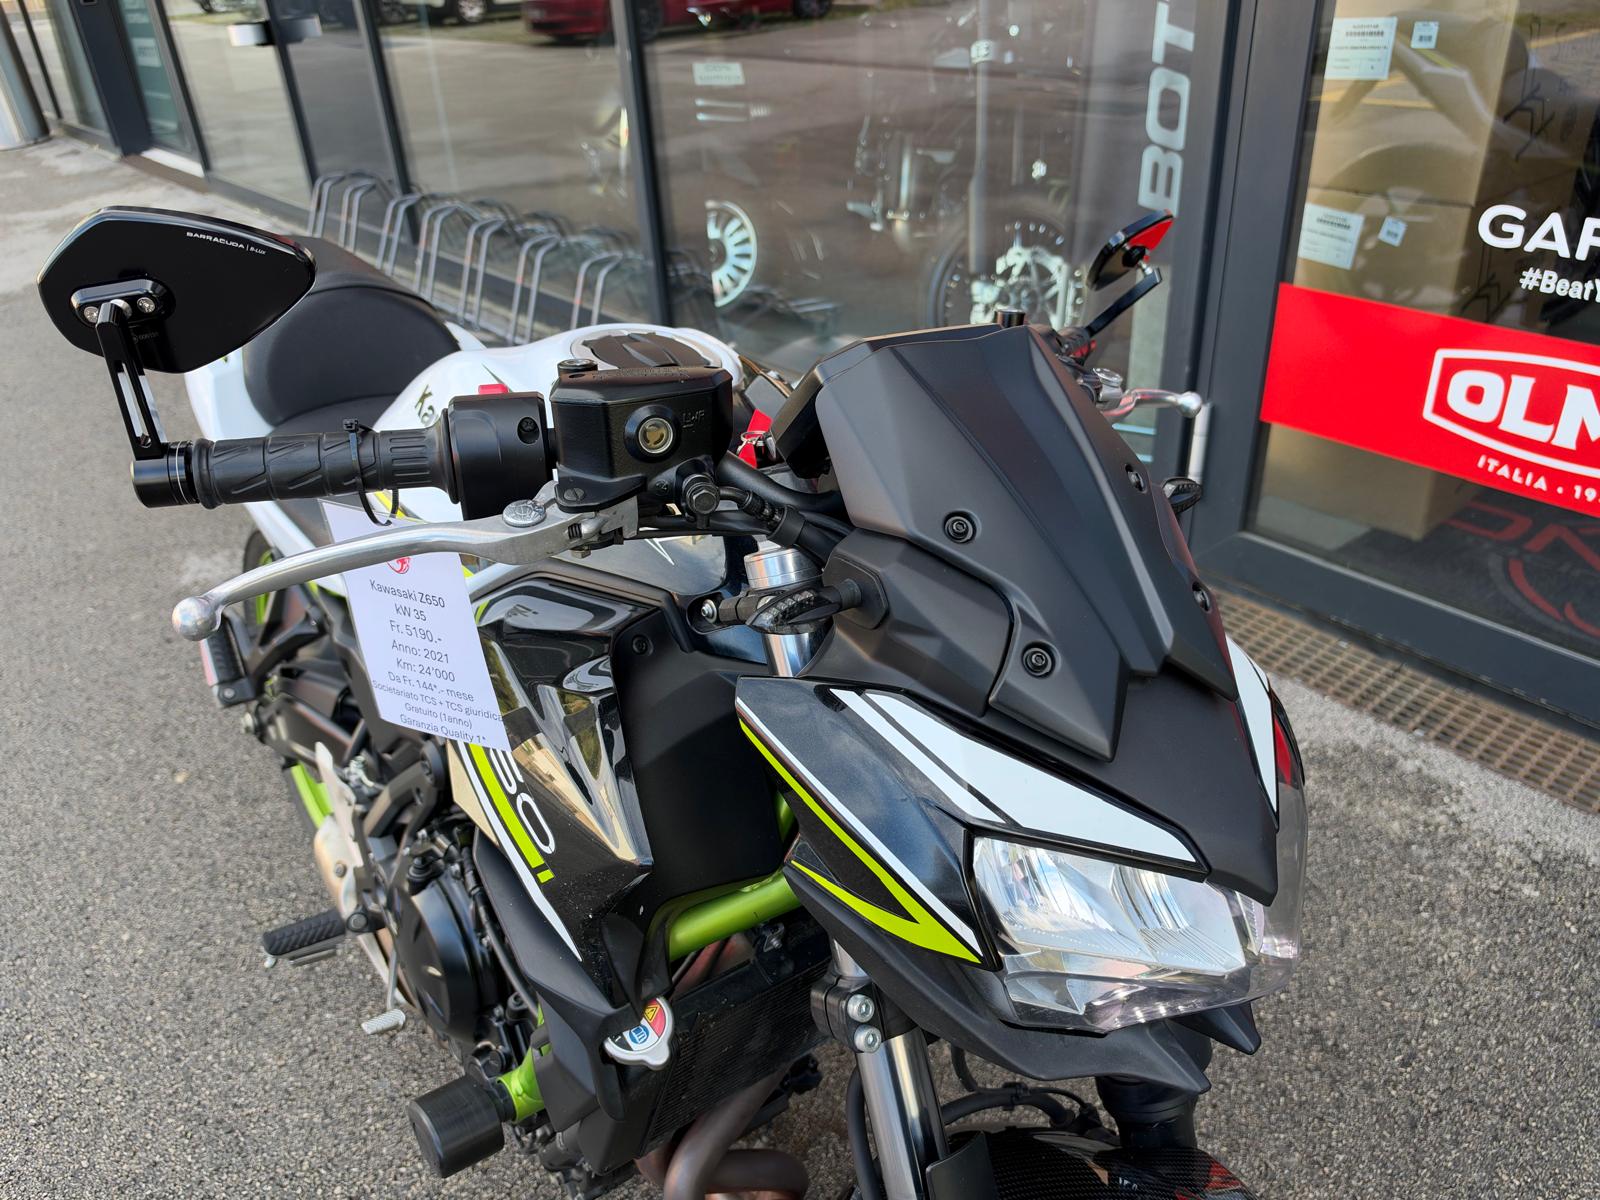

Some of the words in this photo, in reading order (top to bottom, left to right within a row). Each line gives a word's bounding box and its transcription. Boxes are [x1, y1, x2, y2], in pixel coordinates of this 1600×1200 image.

[1137, 0, 1195, 218] BOT
[186, 231, 245, 249] BARRACUDA
[1476, 454, 1548, 492] ITALIA
[1573, 484, 1600, 503] 19
[369, 578, 416, 602] Kawasaki
[419, 592, 446, 608] Z650
[413, 609, 427, 622] 35
[389, 620, 403, 634] Fr.
[406, 627, 442, 644] 5190.-
[391, 640, 421, 657] Anno:
[423, 648, 449, 664] 2021
[396, 657, 417, 673] Km:
[418, 663, 456, 683] 24'000
[388, 671, 401, 683] Da
[402, 675, 415, 688] Fr.
[446, 689, 474, 702] mese
[405, 702, 438, 719] Gratuito
[420, 694, 438, 706] TCS
[445, 701, 463, 713] TCS
[400, 713, 439, 732] Garanzia
[440, 724, 474, 743] Quality
